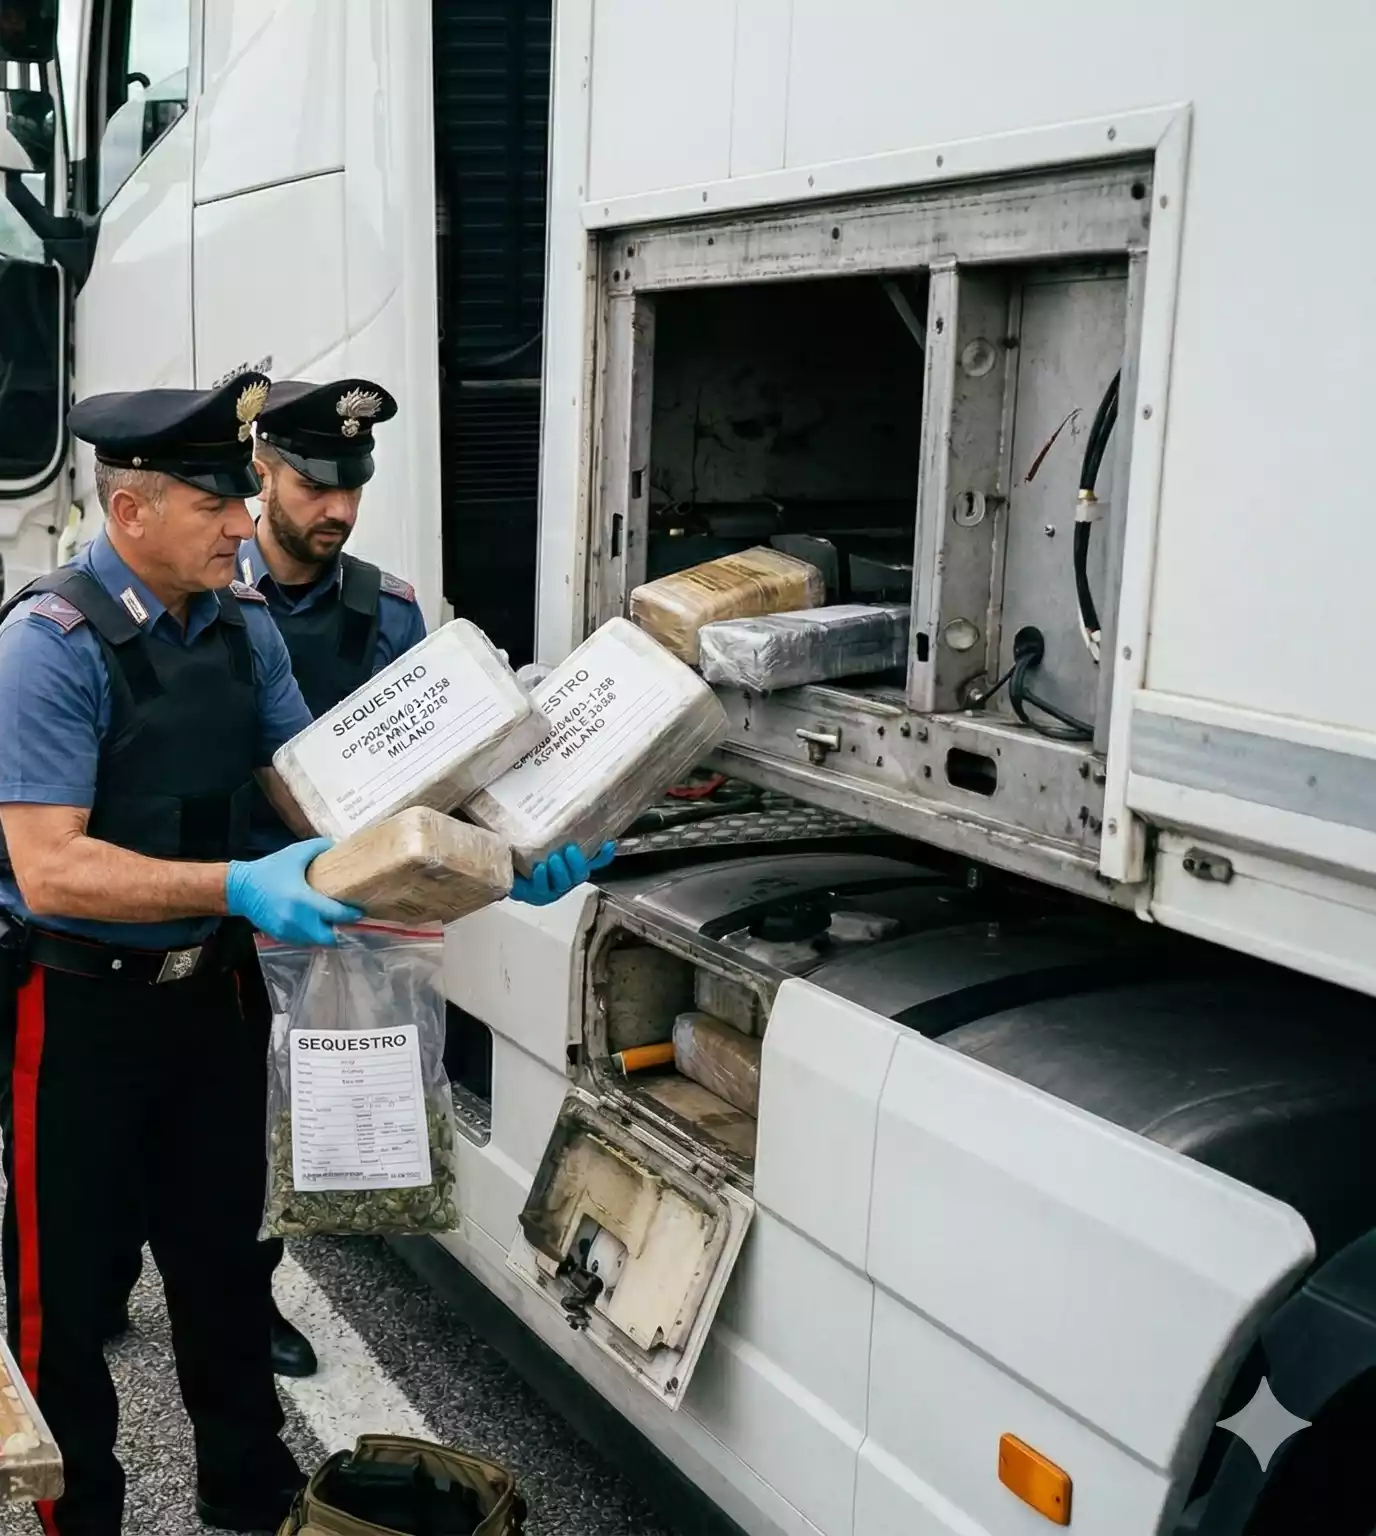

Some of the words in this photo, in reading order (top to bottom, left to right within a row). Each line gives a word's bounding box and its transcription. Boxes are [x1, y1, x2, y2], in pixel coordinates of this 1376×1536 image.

[332, 665, 428, 737] SEQUESTRO
[541, 669, 590, 715] ESTRO
[387, 720, 436, 759] MILANO
[560, 718, 606, 760] MILANO
[297, 1034, 407, 1052] SEQUESTRO
